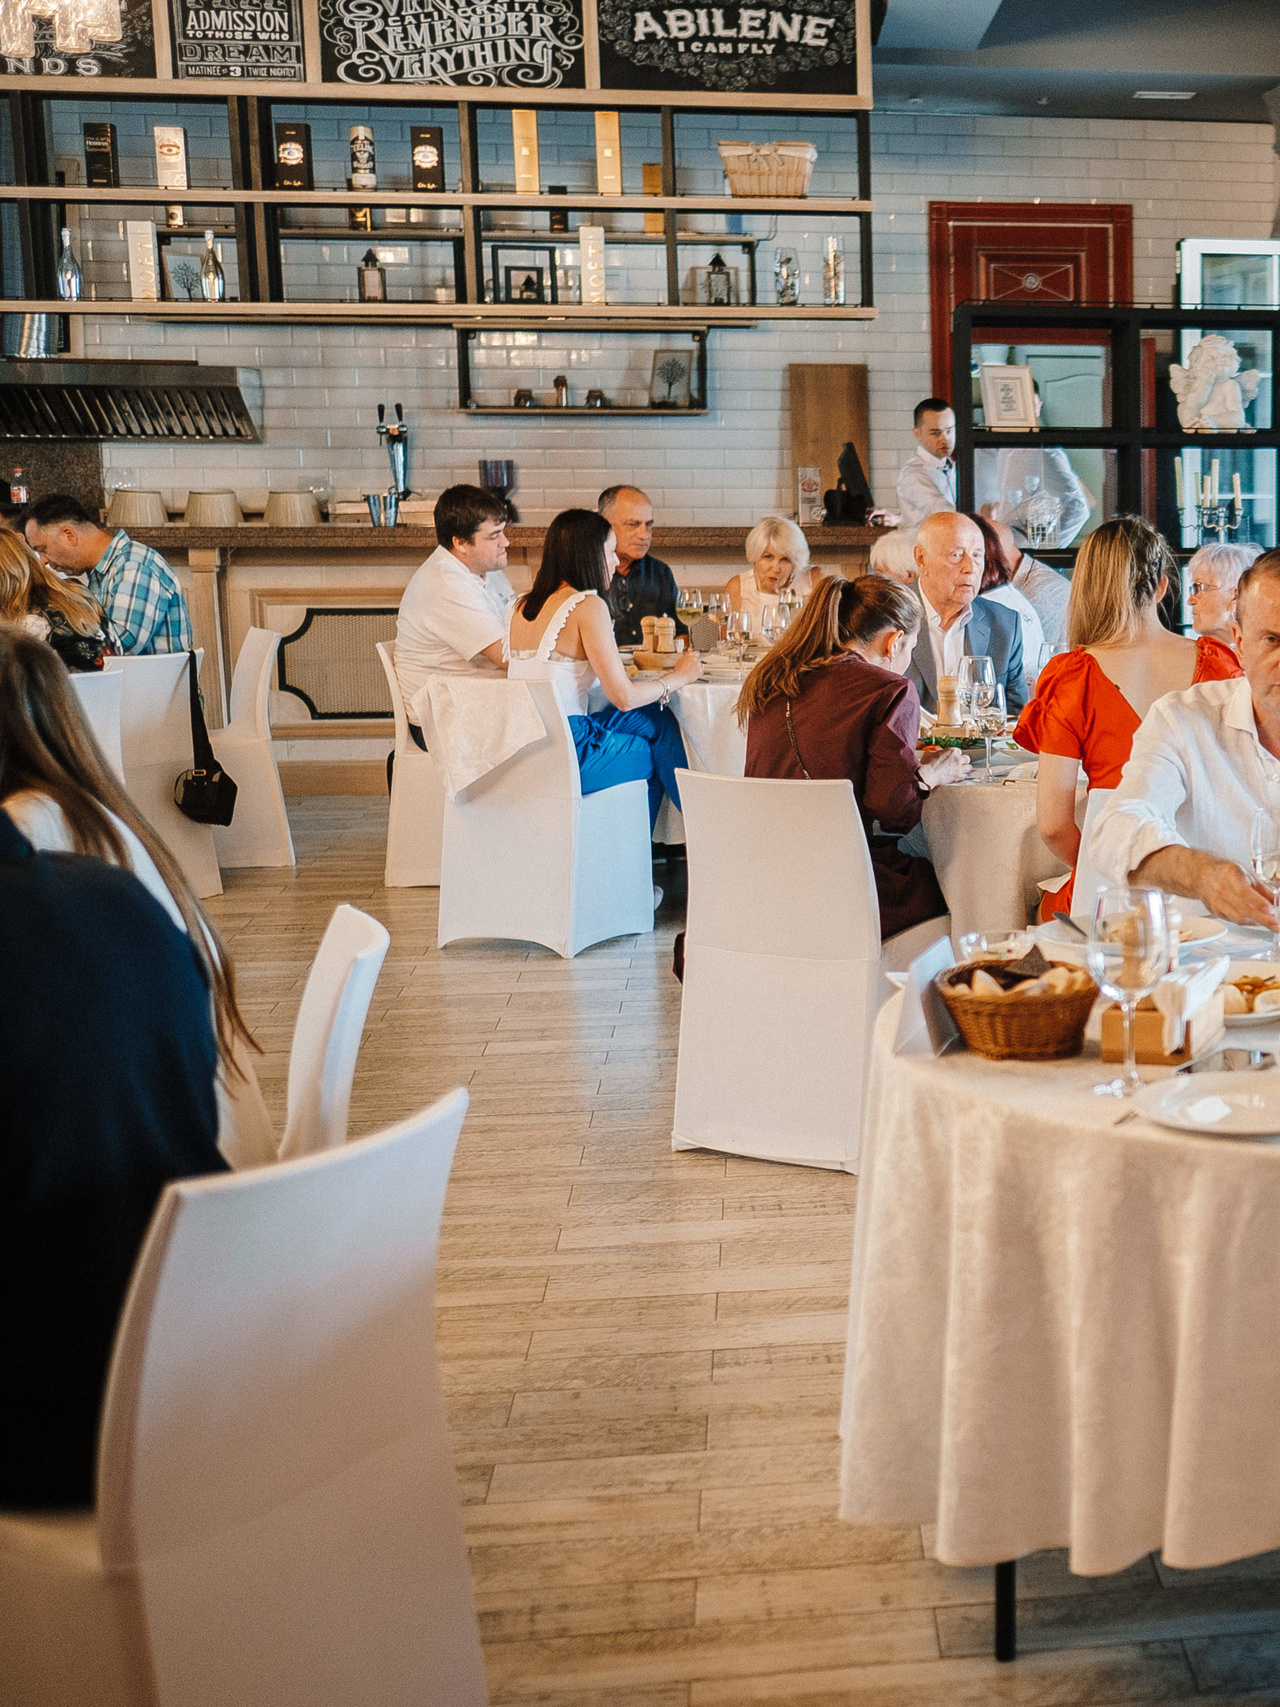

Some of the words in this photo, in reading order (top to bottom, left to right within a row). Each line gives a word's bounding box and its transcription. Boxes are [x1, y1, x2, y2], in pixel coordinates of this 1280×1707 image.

[186, 9, 289, 32] ADMISSION
[387, 2, 538, 26] CALIFORNIA
[186, 30, 204, 38] TO
[205, 31, 253, 39] THOSE
[257, 32, 290, 41] WHO
[344, 12, 562, 51] REMEMBER
[634, 8, 836, 46] ABILENE
[181, 43, 298, 64] DREAM
[678, 41, 685, 52] I
[690, 42, 733, 54] CAN
[737, 42, 776, 54] FLY
[188, 65, 222, 76] MATINEE
[248, 67, 268, 77] TWICE
[336, 38, 562, 88] EVERYTHING
